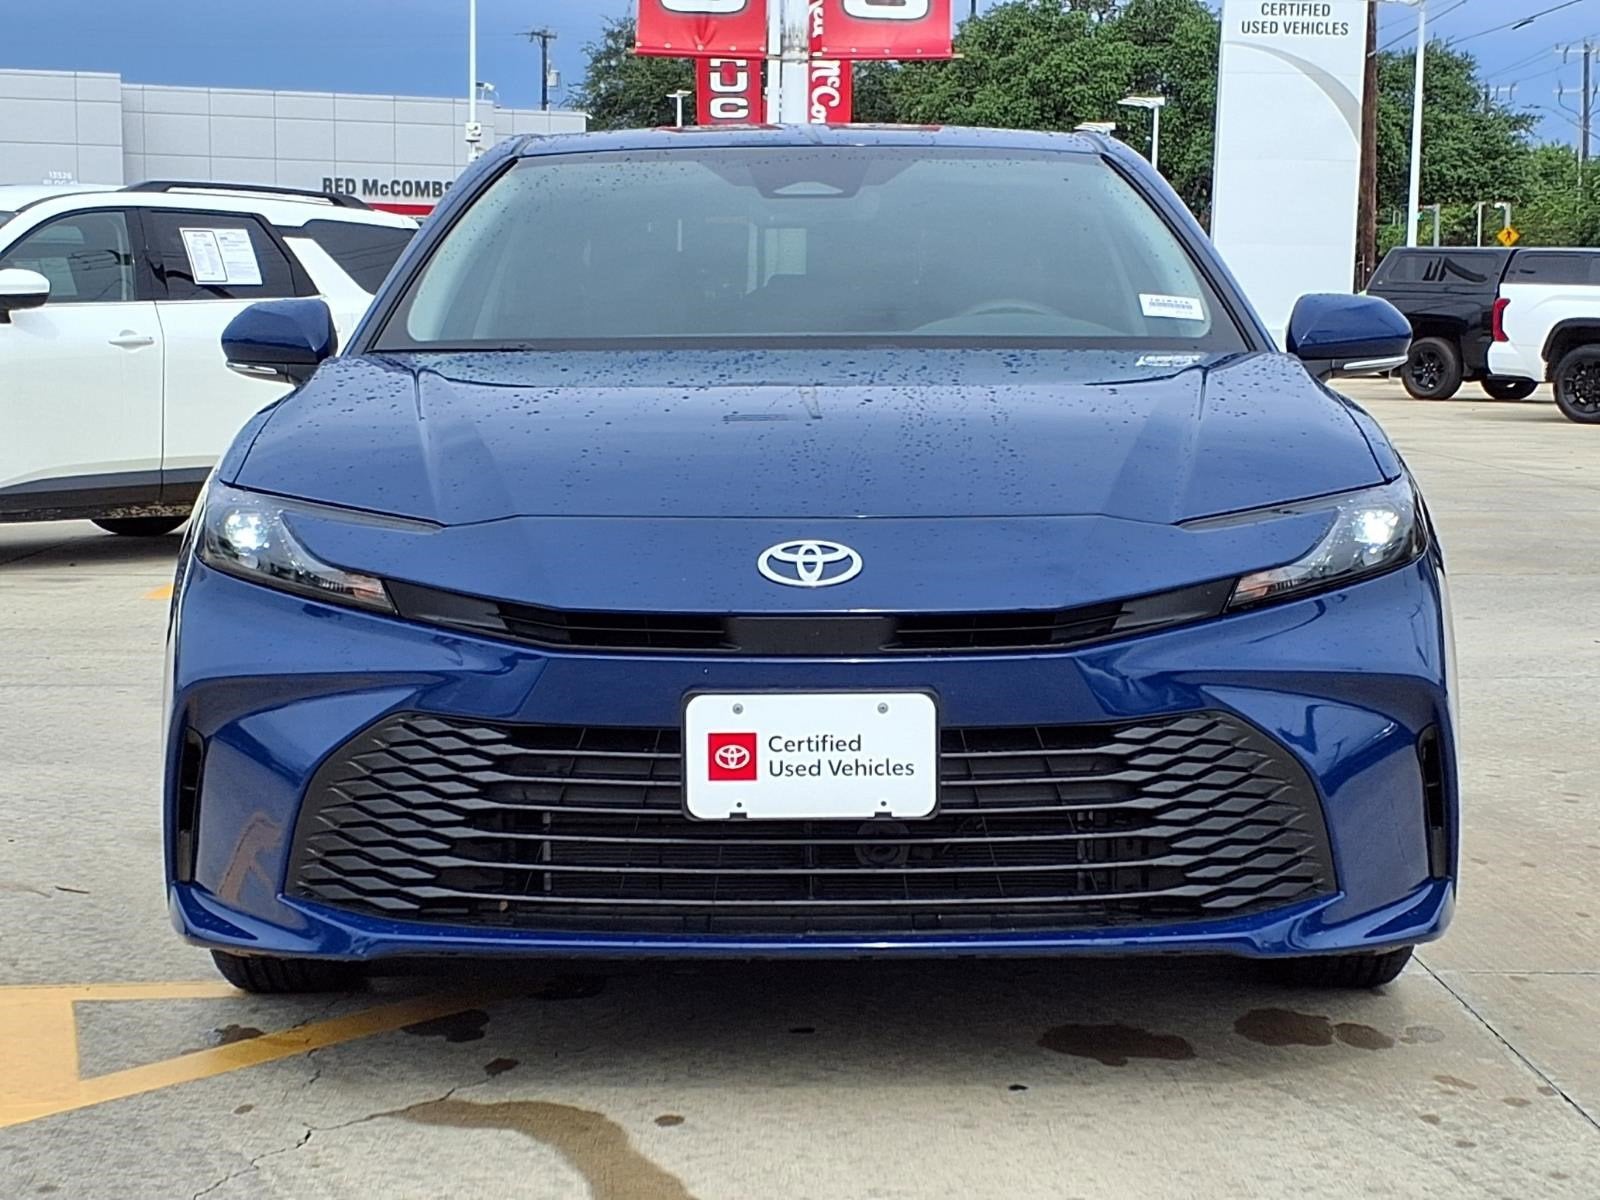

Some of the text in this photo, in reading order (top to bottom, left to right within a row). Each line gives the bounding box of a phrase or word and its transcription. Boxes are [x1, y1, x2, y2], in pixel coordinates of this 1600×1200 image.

[1261, 3, 1331, 17] CERTIFIED
[1241, 20, 1349, 36] USED VEHICLES
[322, 177, 357, 195] RED
[768, 734, 862, 753] Certified
[769, 757, 915, 777] Used Vehicles
